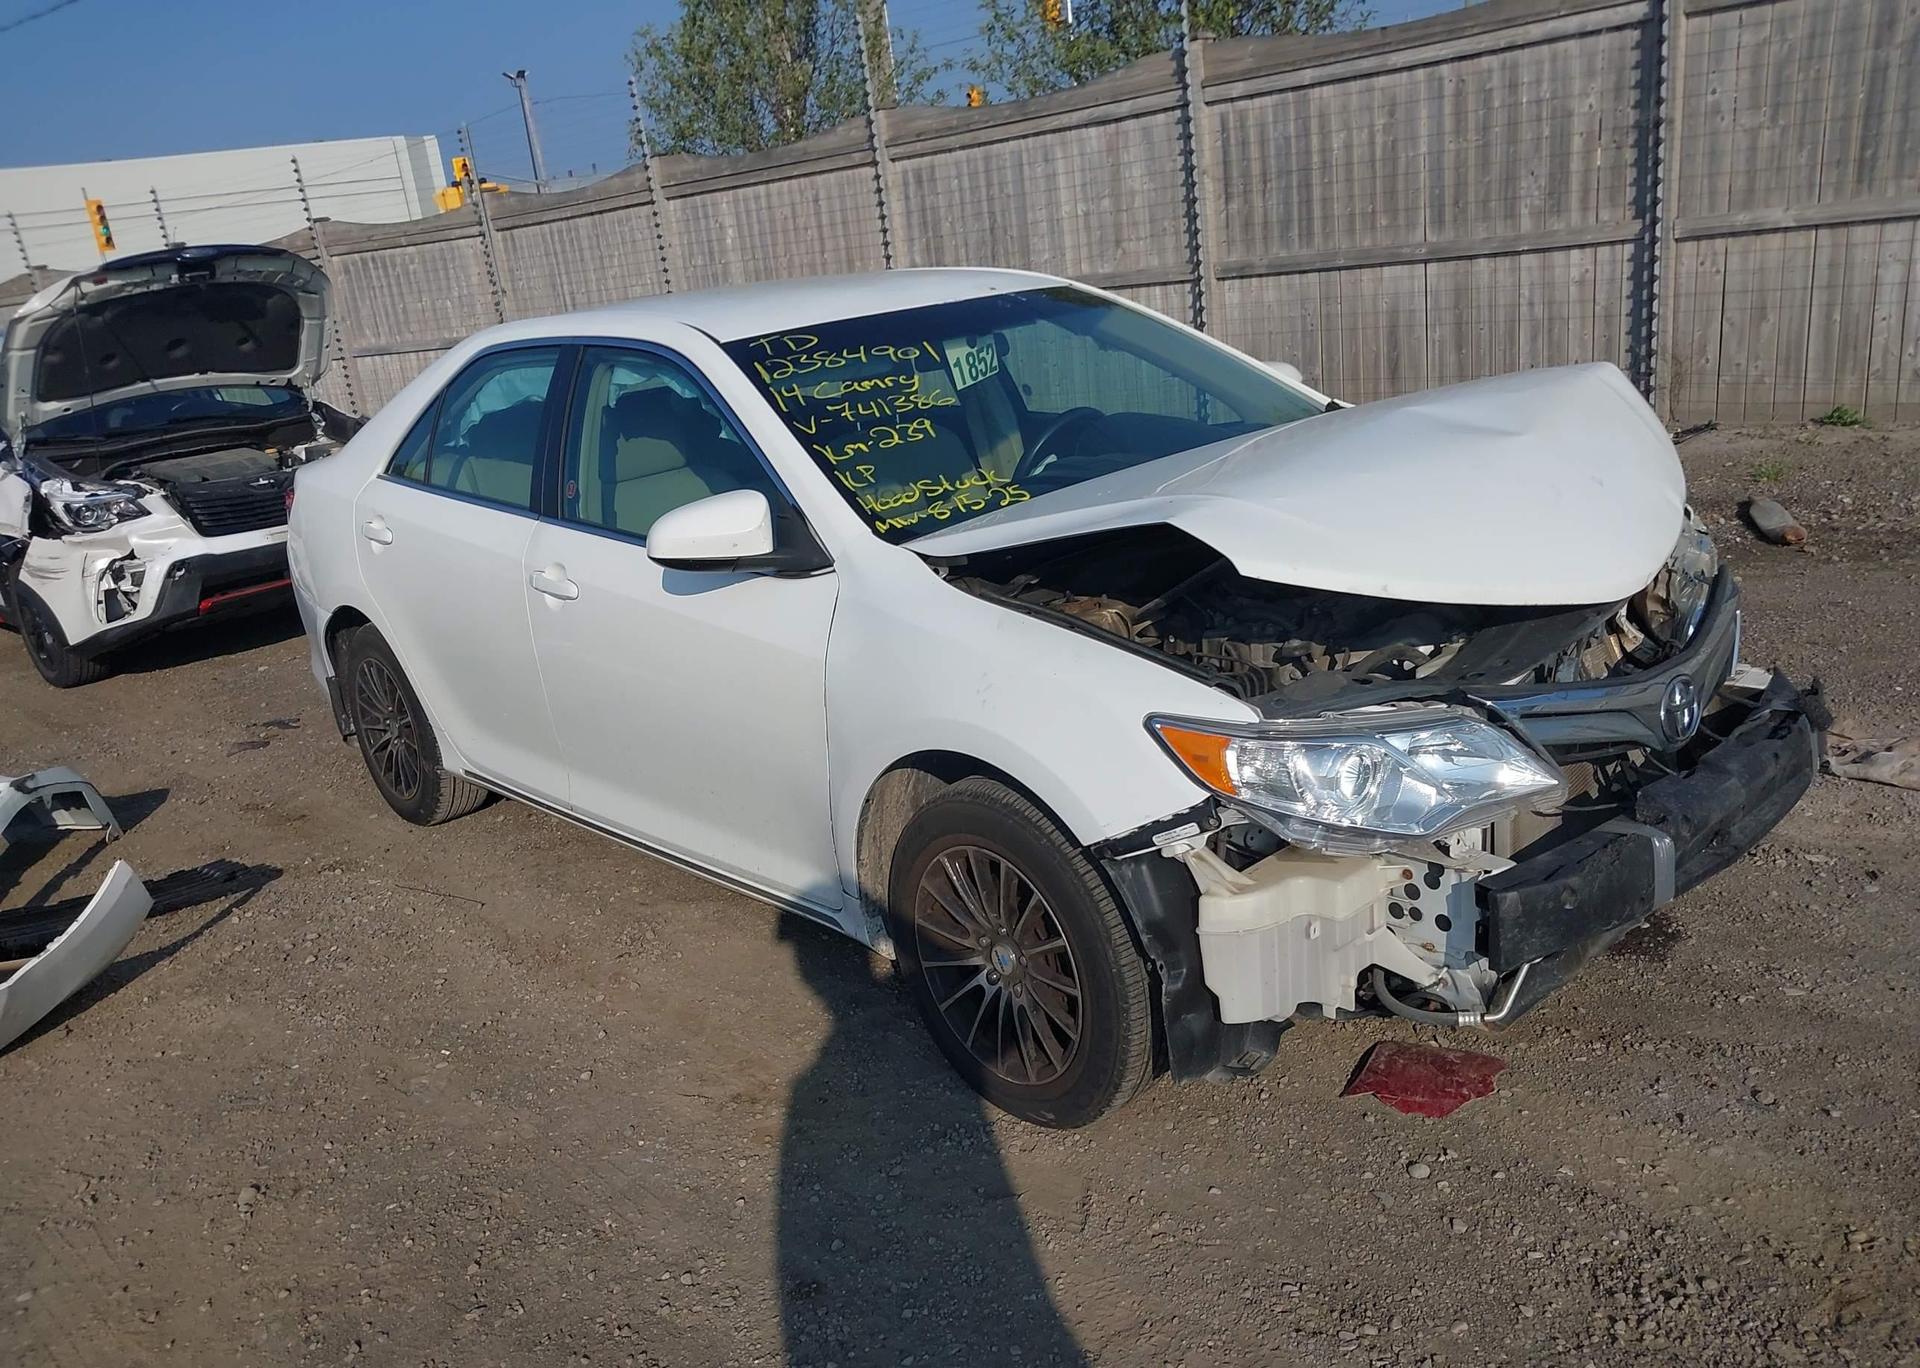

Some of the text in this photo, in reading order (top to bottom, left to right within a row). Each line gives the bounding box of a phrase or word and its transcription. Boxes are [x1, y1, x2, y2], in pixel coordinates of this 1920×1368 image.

[750, 334, 819, 355] TD
[953, 343, 998, 386] 1852
[769, 373, 920, 413] 14 Camry
